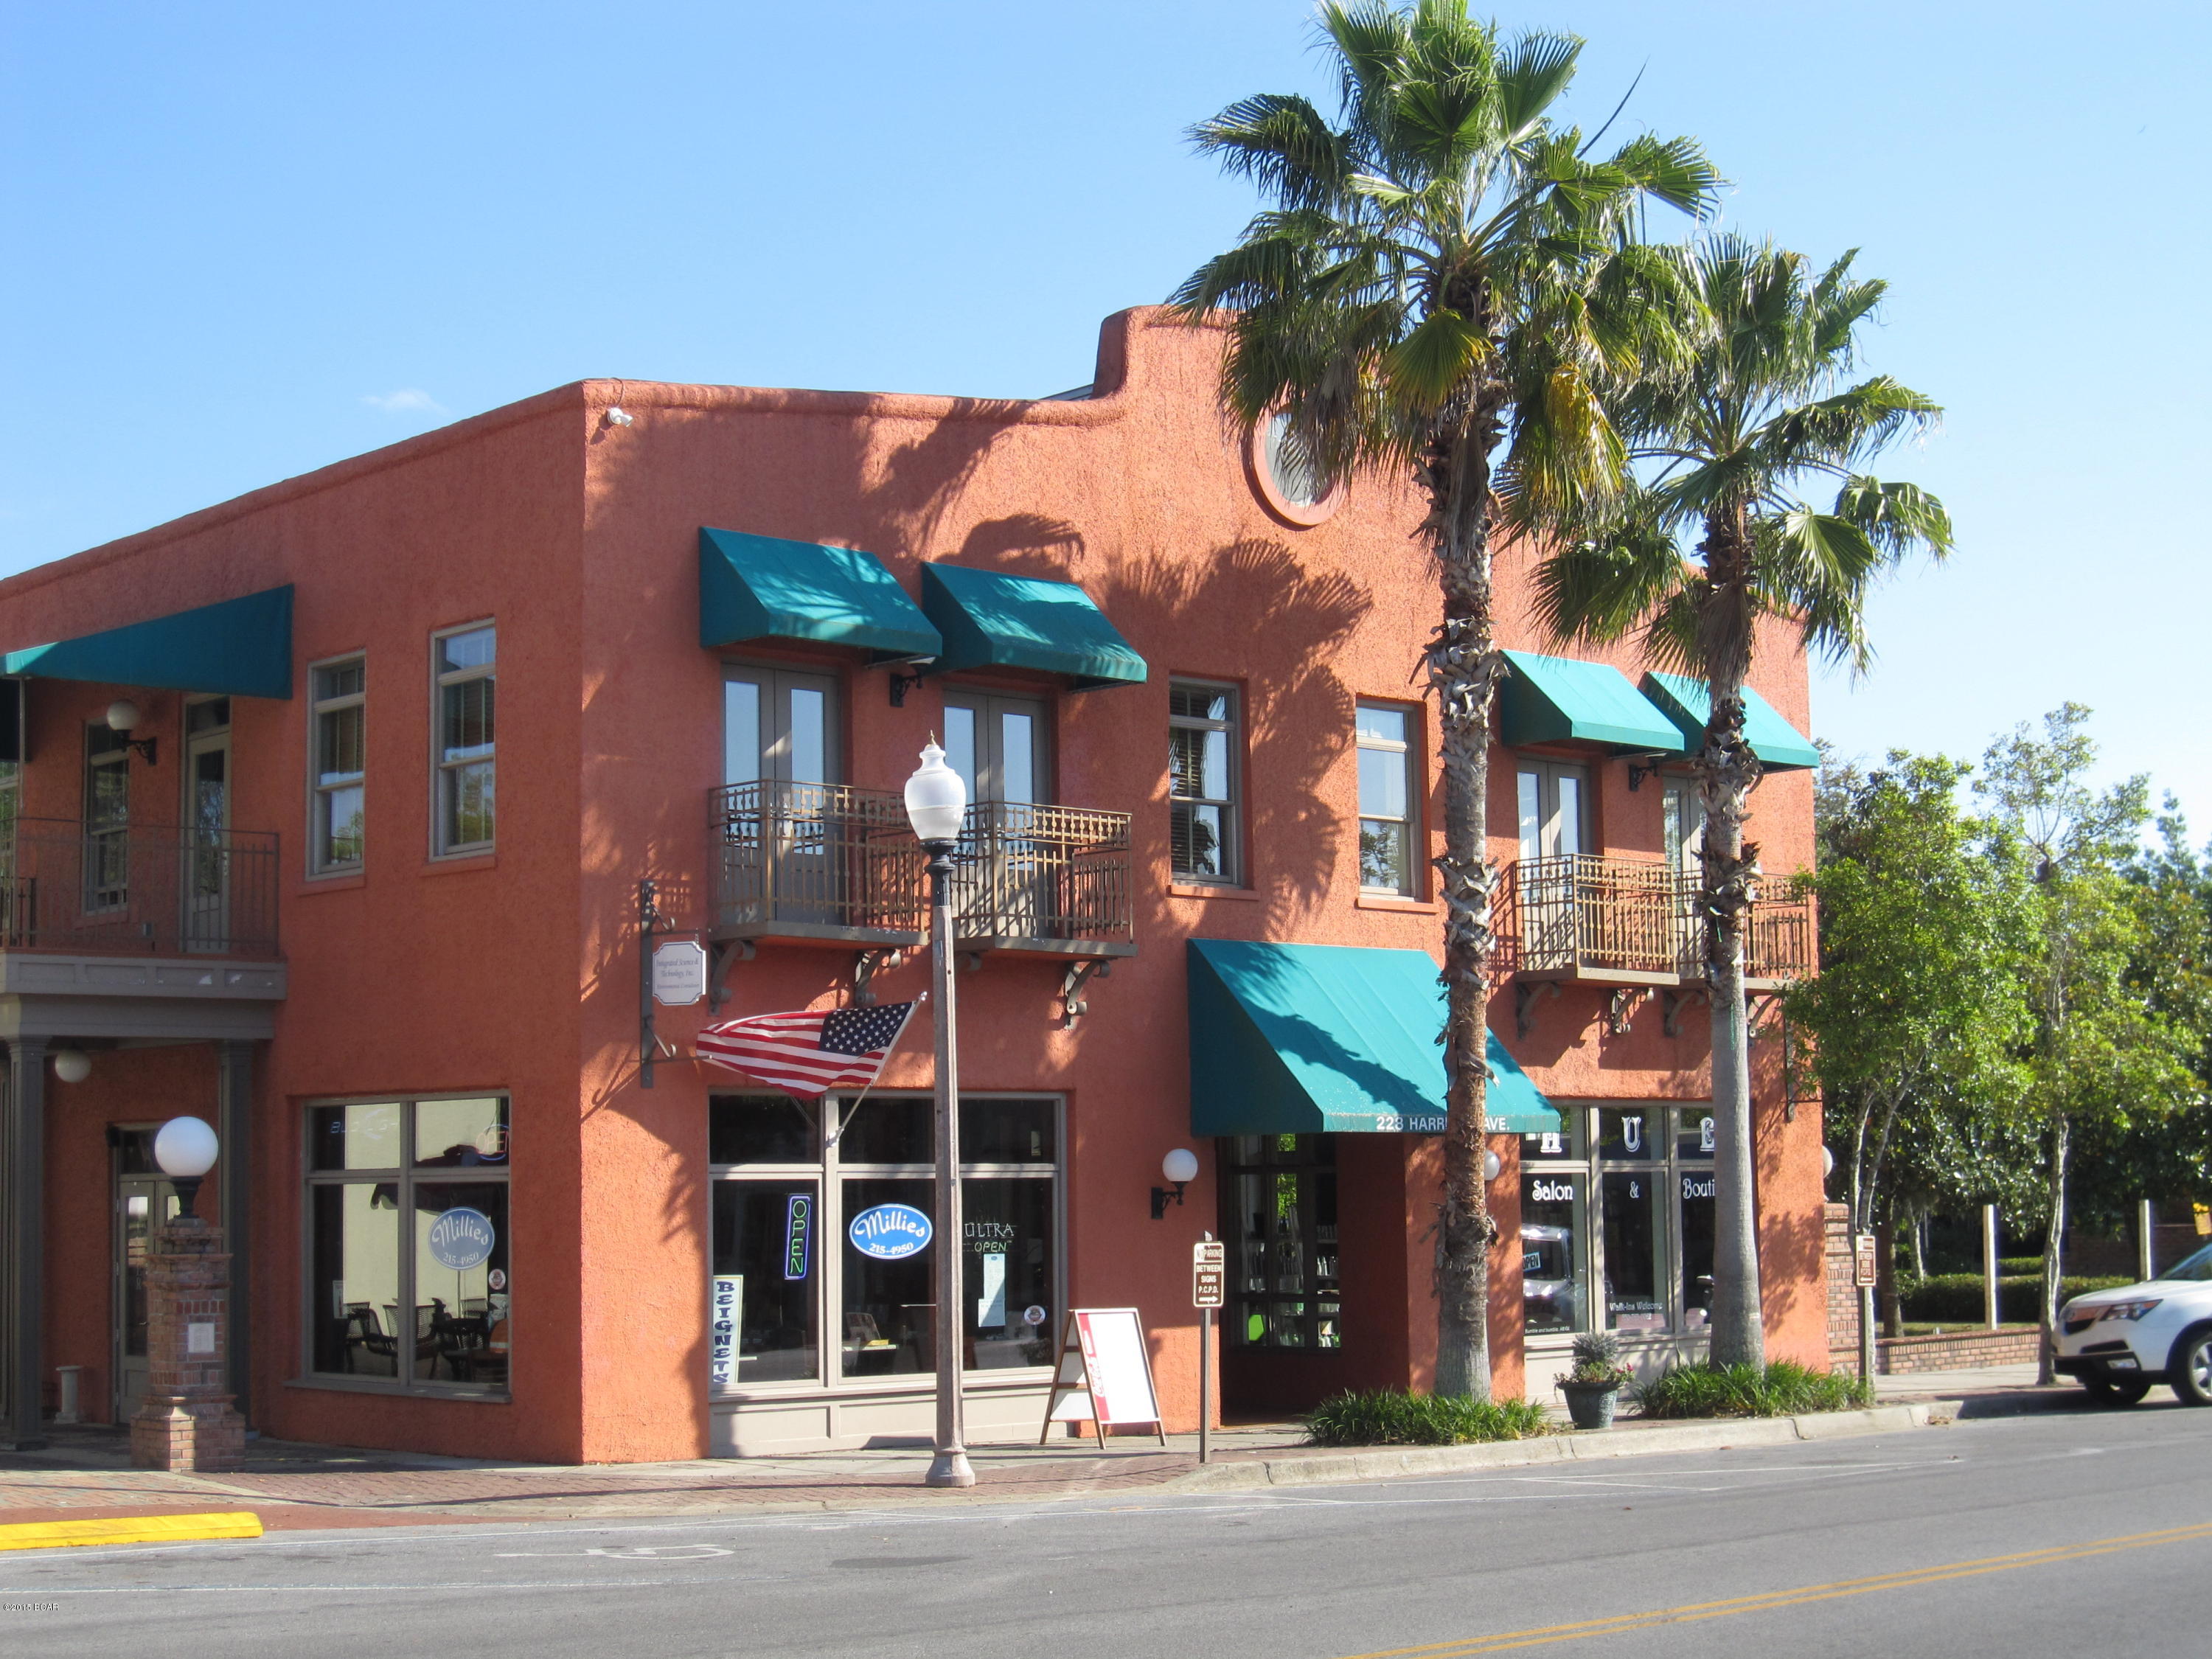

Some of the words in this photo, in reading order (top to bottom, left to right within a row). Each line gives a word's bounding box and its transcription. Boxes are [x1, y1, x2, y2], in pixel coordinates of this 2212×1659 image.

[1376, 1116, 1404, 1130] 228
[476, 1131, 509, 1155] OPE
[1532, 1180, 1573, 1201] Salon
[1629, 1181, 1639, 1198] &
[1683, 1178, 1715, 1200] Bouti
[431, 1215, 489, 1248] Millies
[854, 1211, 925, 1239] Millies
[964, 1222, 1015, 1237] ULTRA
[788, 1200, 807, 1273] OPEN
[869, 1242, 914, 1255] 215-4950
[974, 1242, 1007, 1253] OPEN
[1196, 1265, 1222, 1273] BETWEEN
[1200, 1275, 1217, 1283] SIGNS
[1198, 1285, 1219, 1294] P.C.P.D.
[714, 1281, 735, 1384] BEIGNETS
